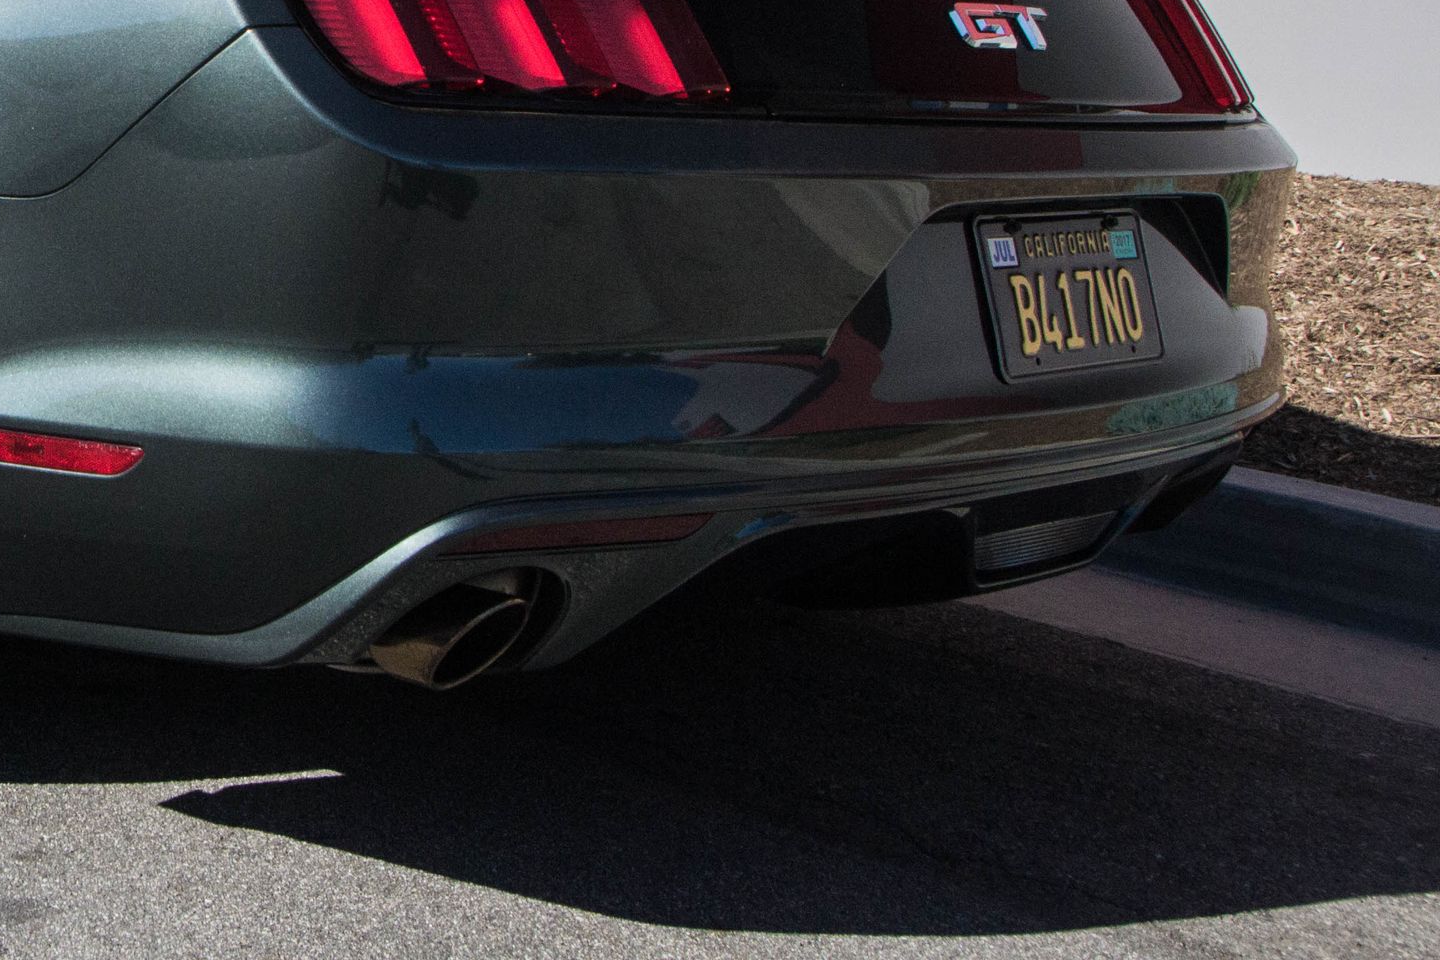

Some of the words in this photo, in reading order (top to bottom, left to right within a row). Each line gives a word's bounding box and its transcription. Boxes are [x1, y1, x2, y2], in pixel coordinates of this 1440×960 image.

[948, 2, 1048, 50] GT
[993, 240, 1015, 262] JUL
[1024, 230, 1110, 257] CALIFORNIA
